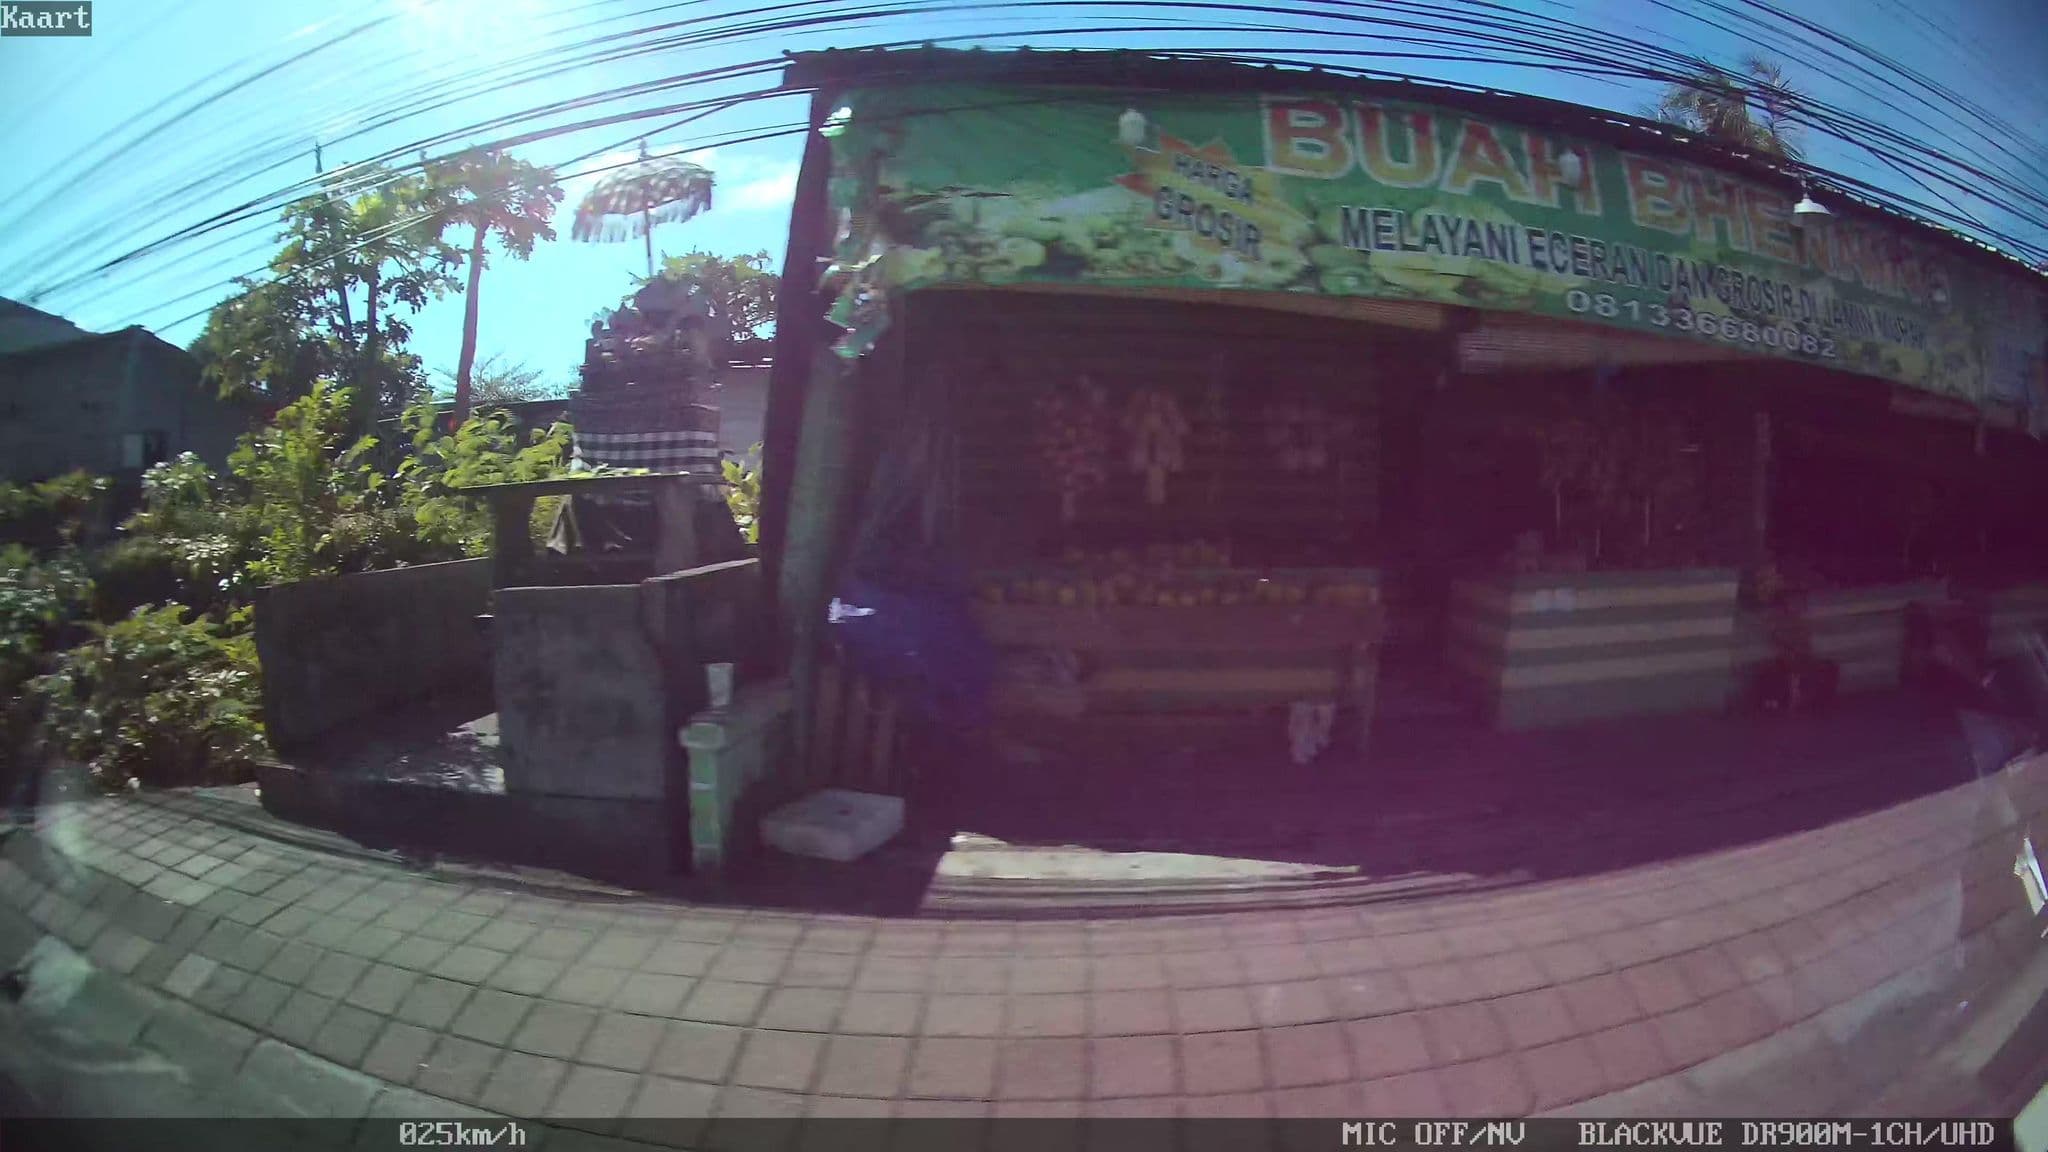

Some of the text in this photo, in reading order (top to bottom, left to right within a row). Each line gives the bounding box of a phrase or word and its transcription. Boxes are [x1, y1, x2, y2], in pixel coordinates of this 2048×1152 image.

[1261, 94, 1601, 217] BUAH
[1154, 184, 1265, 263] GROSIR
[1339, 204, 1521, 265] MELAYANI
[1525, 225, 1650, 288] ECERAN
[1653, 251, 1713, 300] DAN
